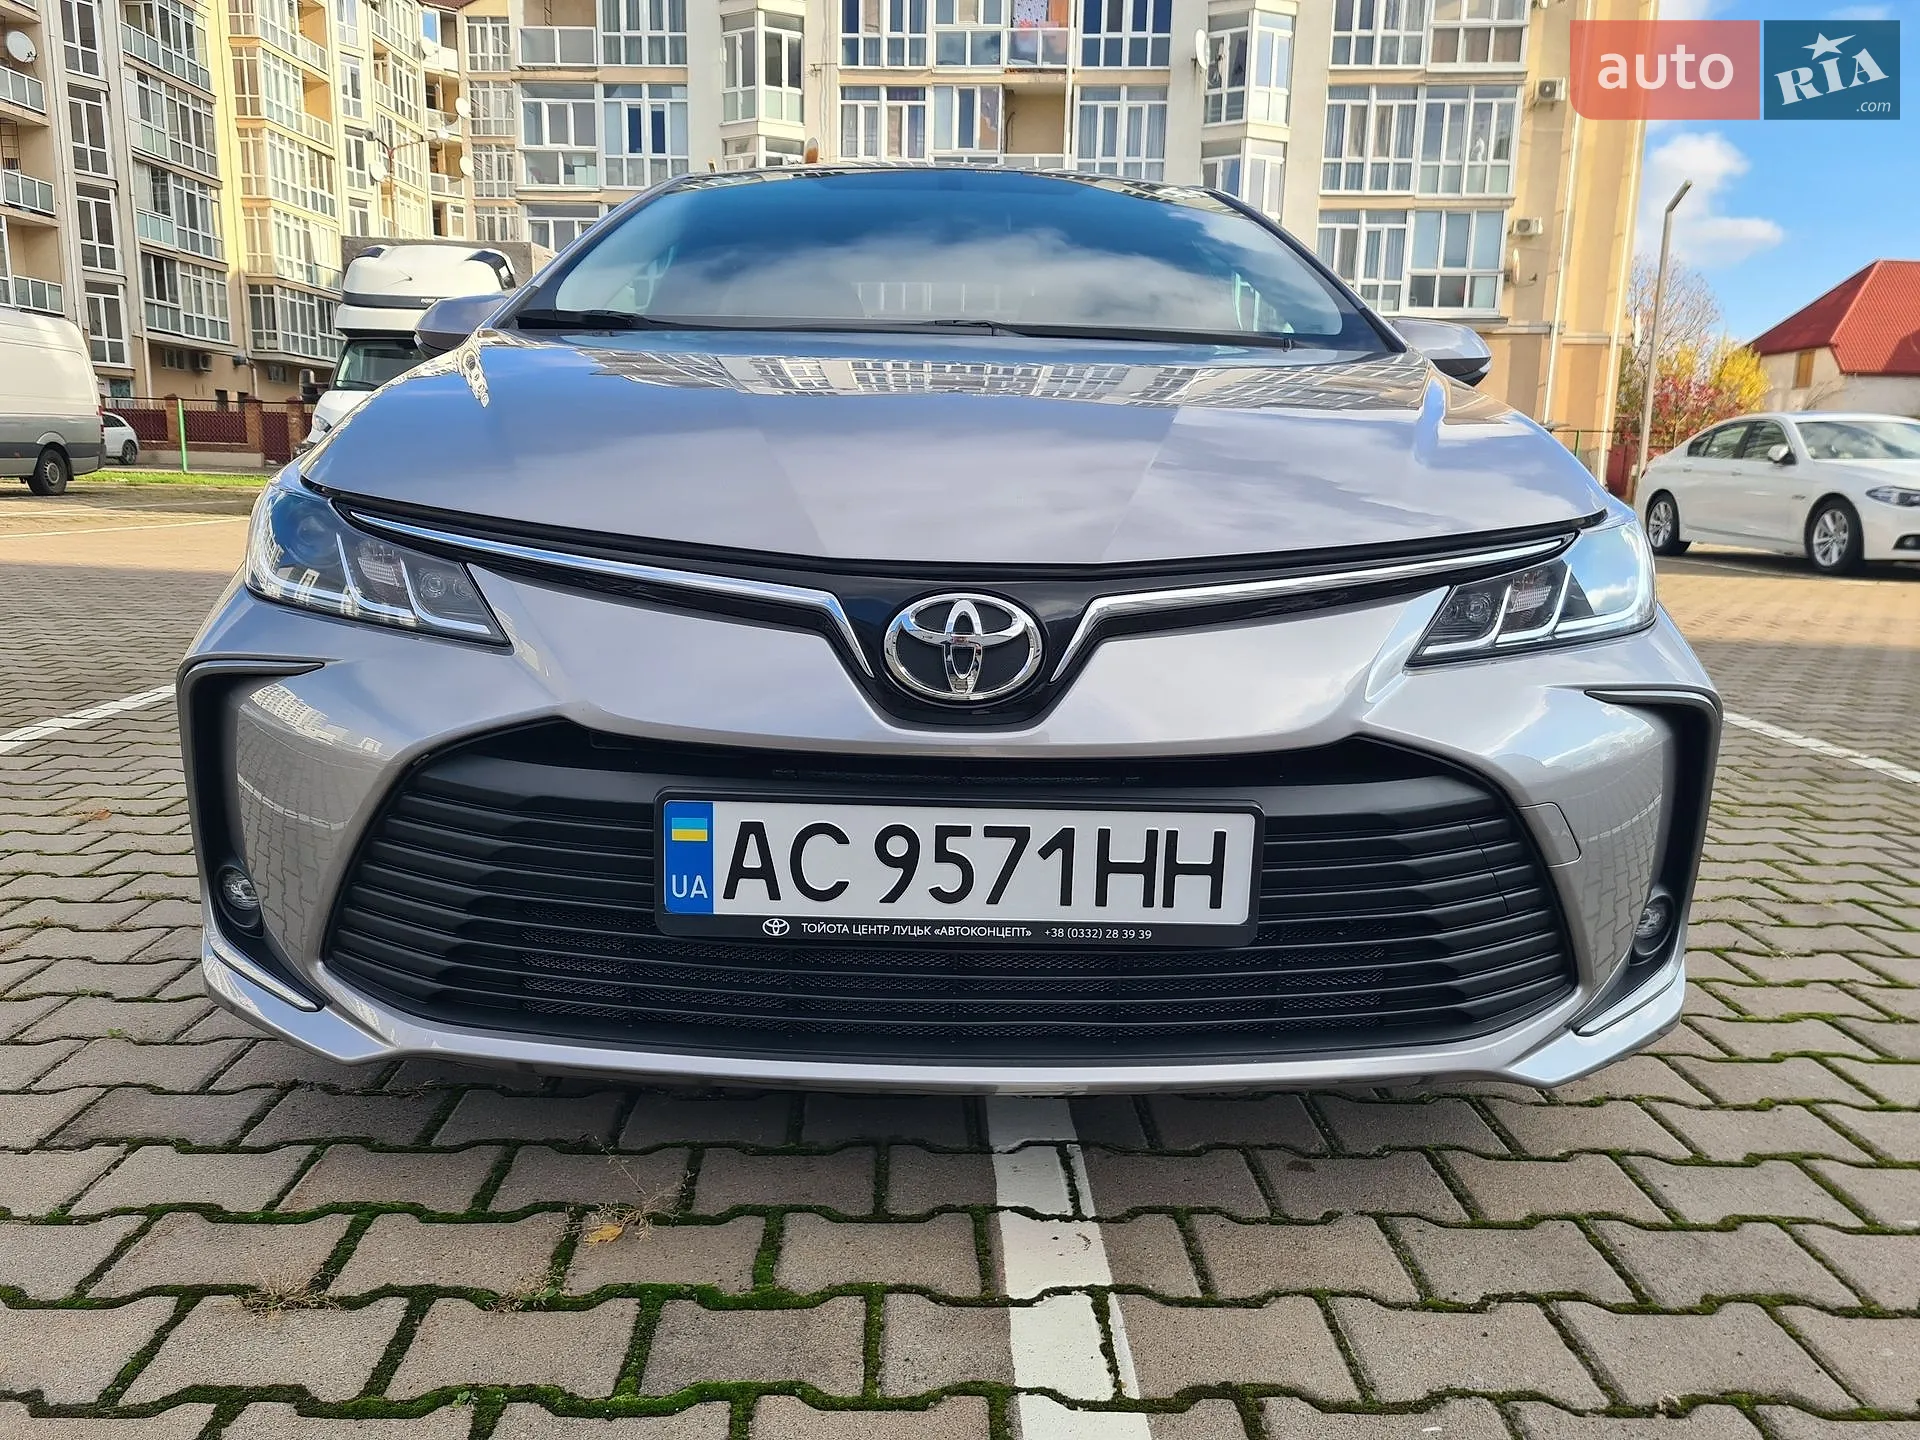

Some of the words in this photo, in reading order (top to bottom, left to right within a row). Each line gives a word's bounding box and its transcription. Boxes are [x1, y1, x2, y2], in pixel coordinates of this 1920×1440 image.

[722, 820, 850, 903] AC
[672, 874, 708, 899] UA
[801, 921, 850, 934] ТОЙОТА
[852, 924, 890, 936] ЦЕНТР
[892, 925, 932, 938] ЛУЦЬК
[1044, 927, 1065, 938] +38
[1067, 927, 1103, 940] (0332)
[1105, 928, 1119, 939] 28
[1121, 929, 1136, 939] 39
[1138, 929, 1152, 940] 39
